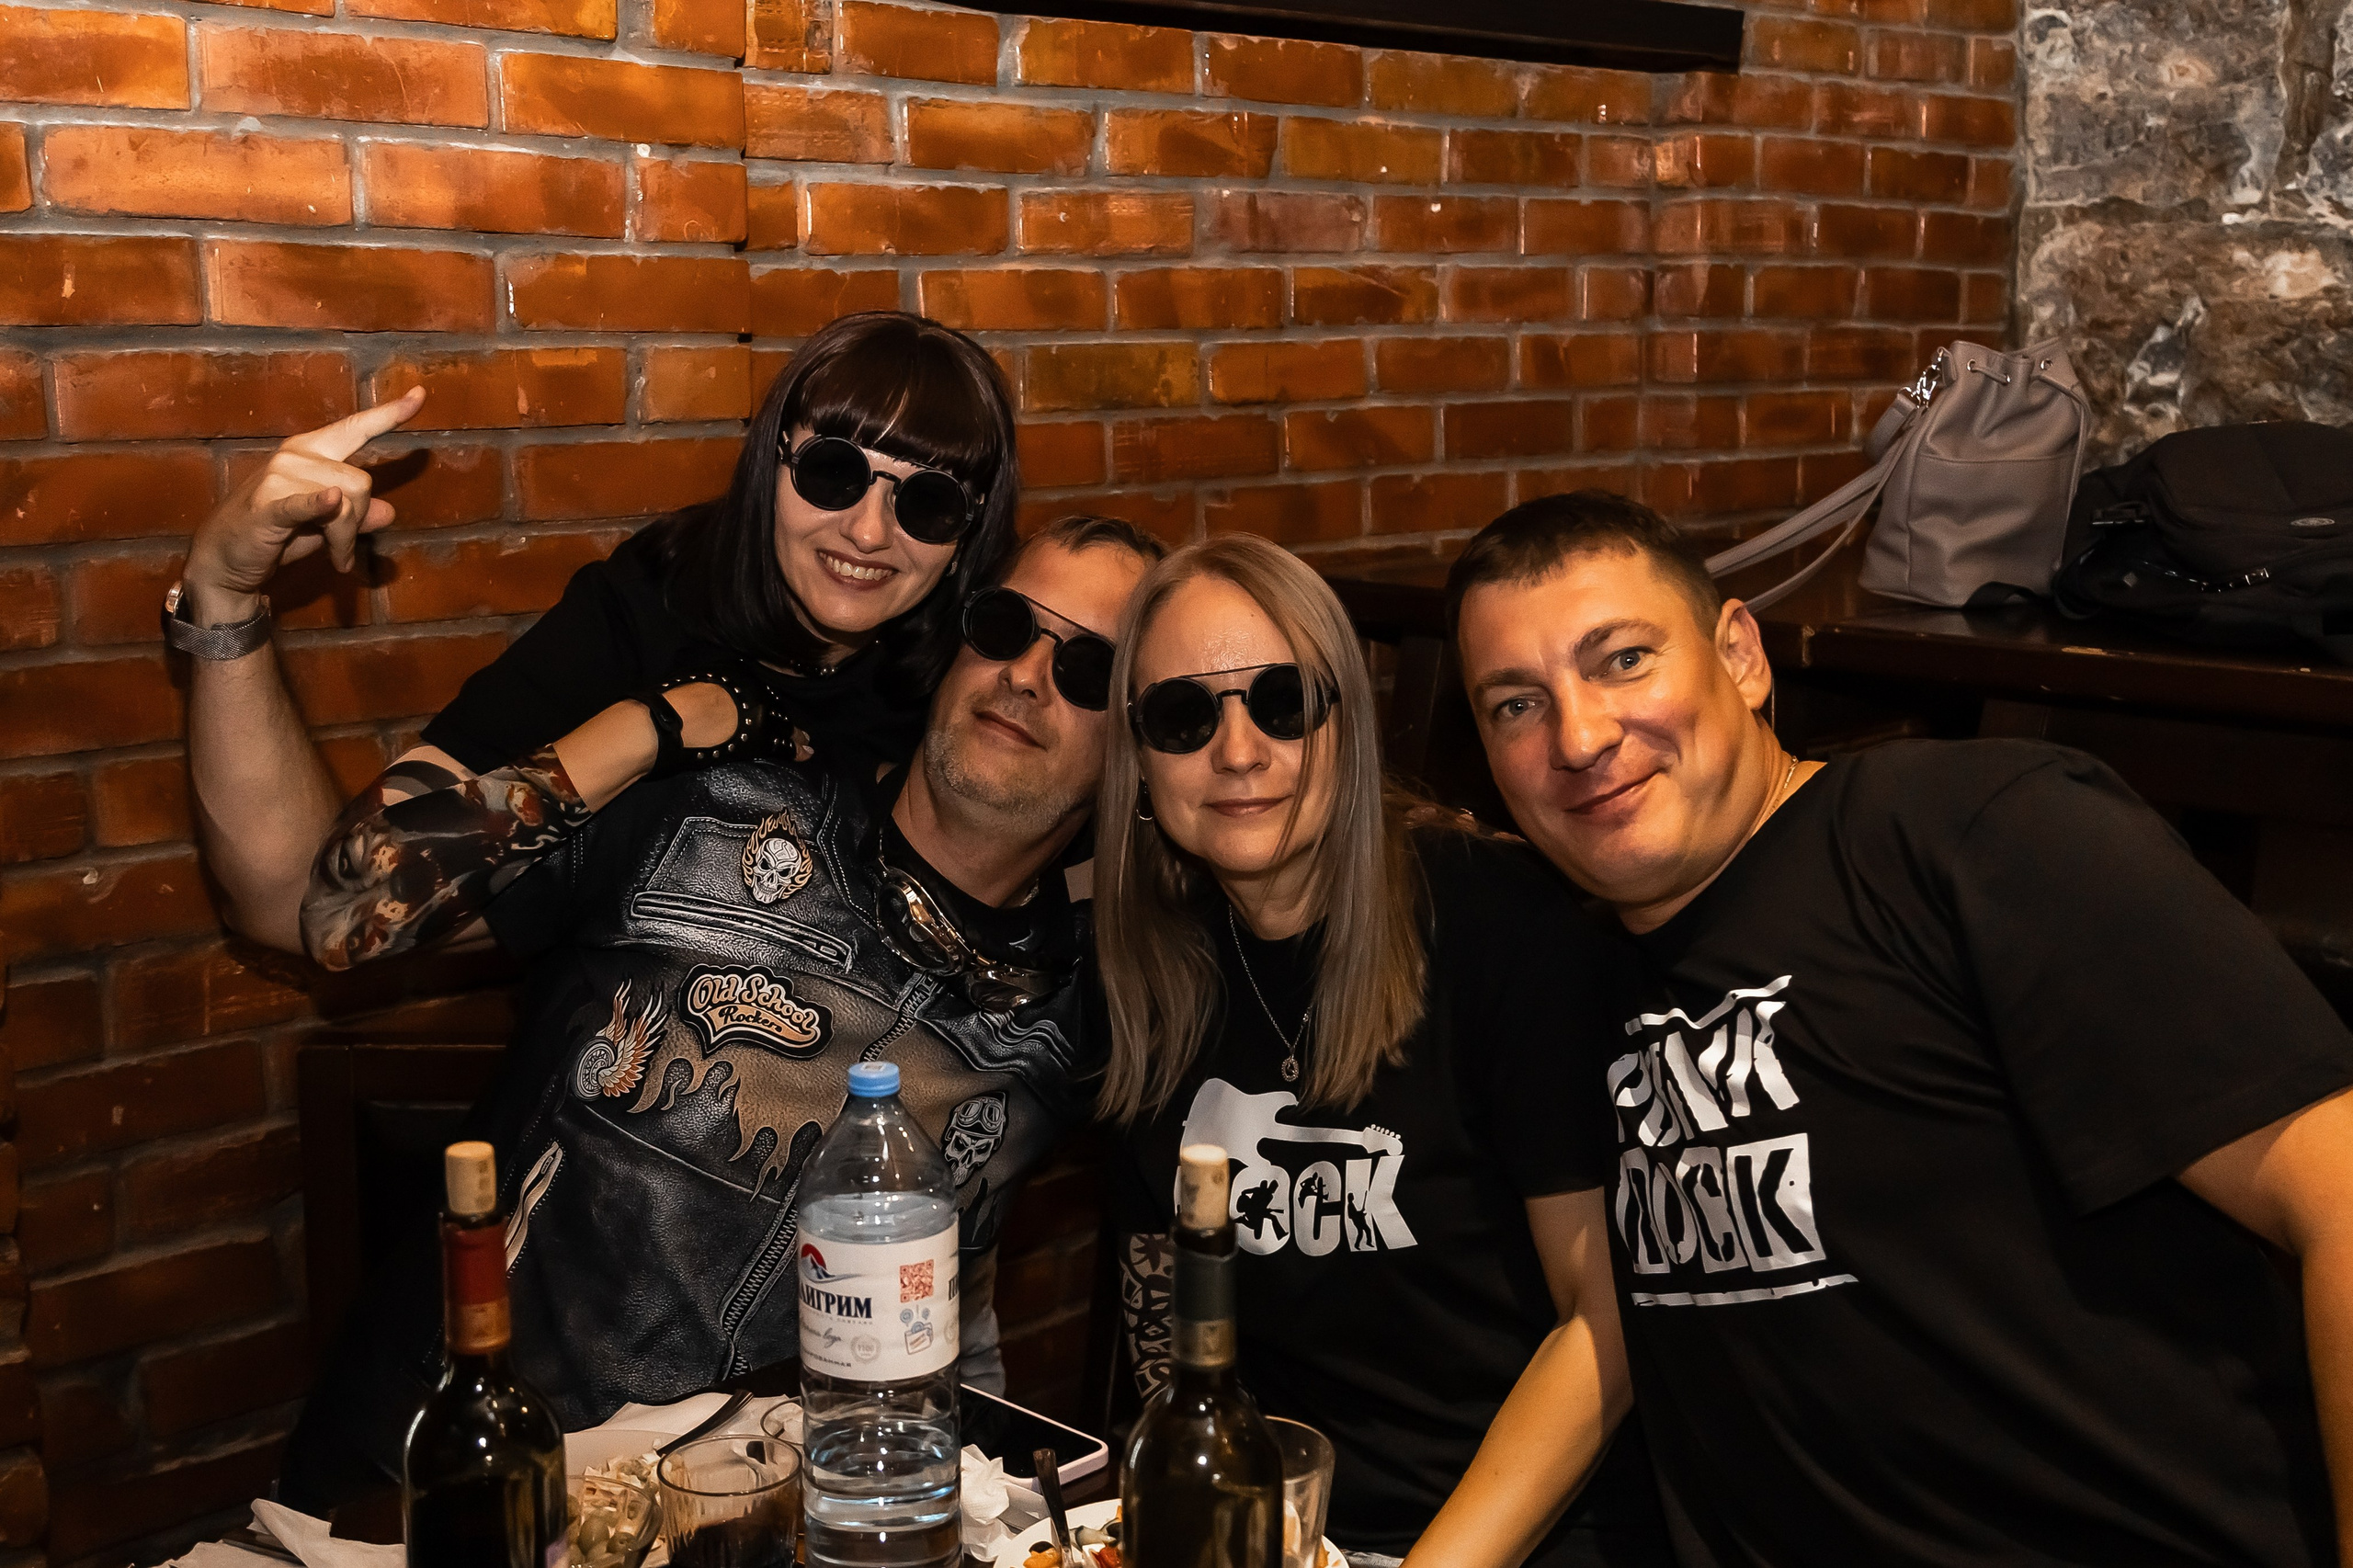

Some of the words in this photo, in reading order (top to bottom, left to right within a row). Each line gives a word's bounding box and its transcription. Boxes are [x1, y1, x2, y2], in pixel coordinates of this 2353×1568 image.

[689, 974, 738, 1013] Old
[739, 974, 819, 1035] School
[1174, 1154, 1418, 1256] OCK
